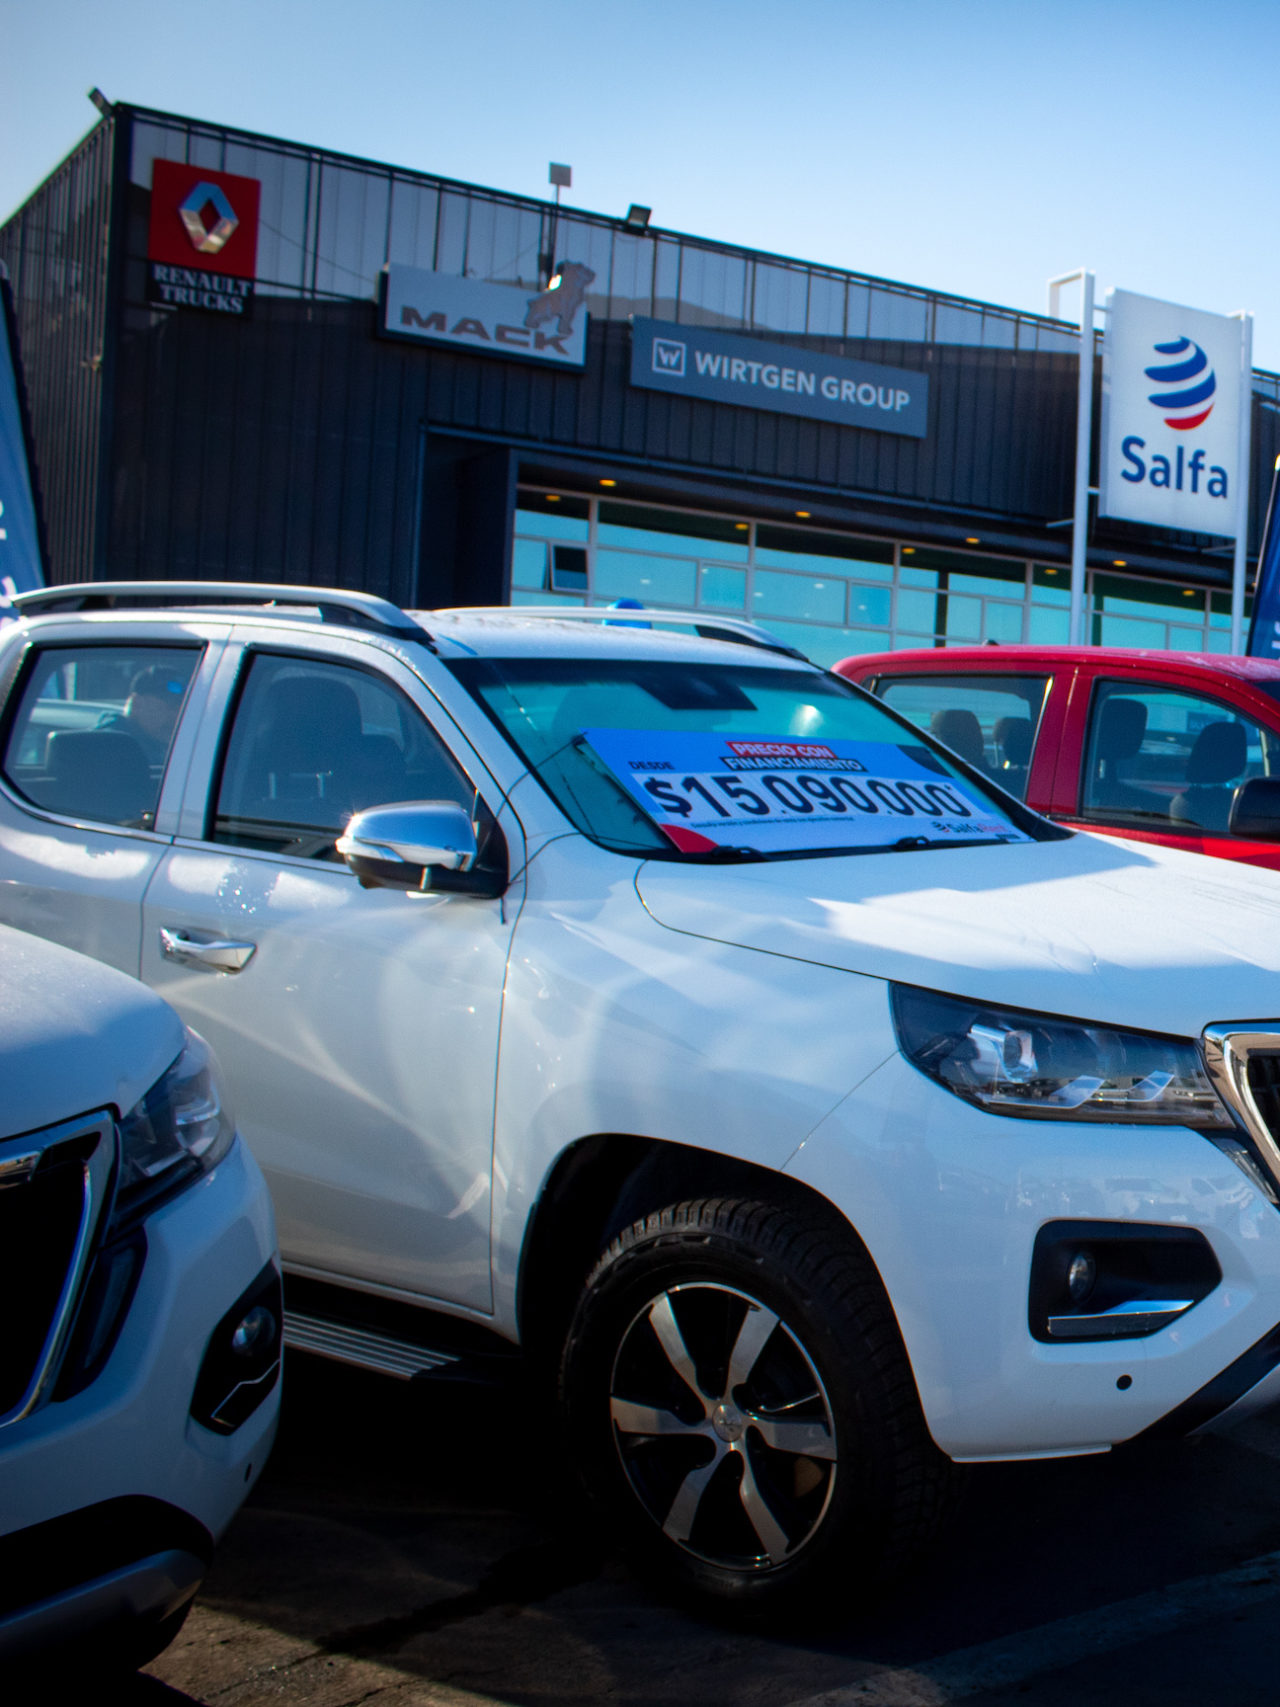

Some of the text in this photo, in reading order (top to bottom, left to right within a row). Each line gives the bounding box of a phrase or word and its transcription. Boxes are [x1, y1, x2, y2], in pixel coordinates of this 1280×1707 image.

[153, 264, 251, 296] RENAULT
[160, 284, 243, 313] TRUCKS
[401, 305, 570, 355] MACK
[695, 350, 816, 396] WIRTGEN
[820, 375, 911, 412] GROUP
[1121, 435, 1228, 499] Salfa
[628, 761, 675, 770] DESDE
[724, 758, 864, 770] FINANCIAMIENTO
[732, 743, 831, 758] PRECIO CON
